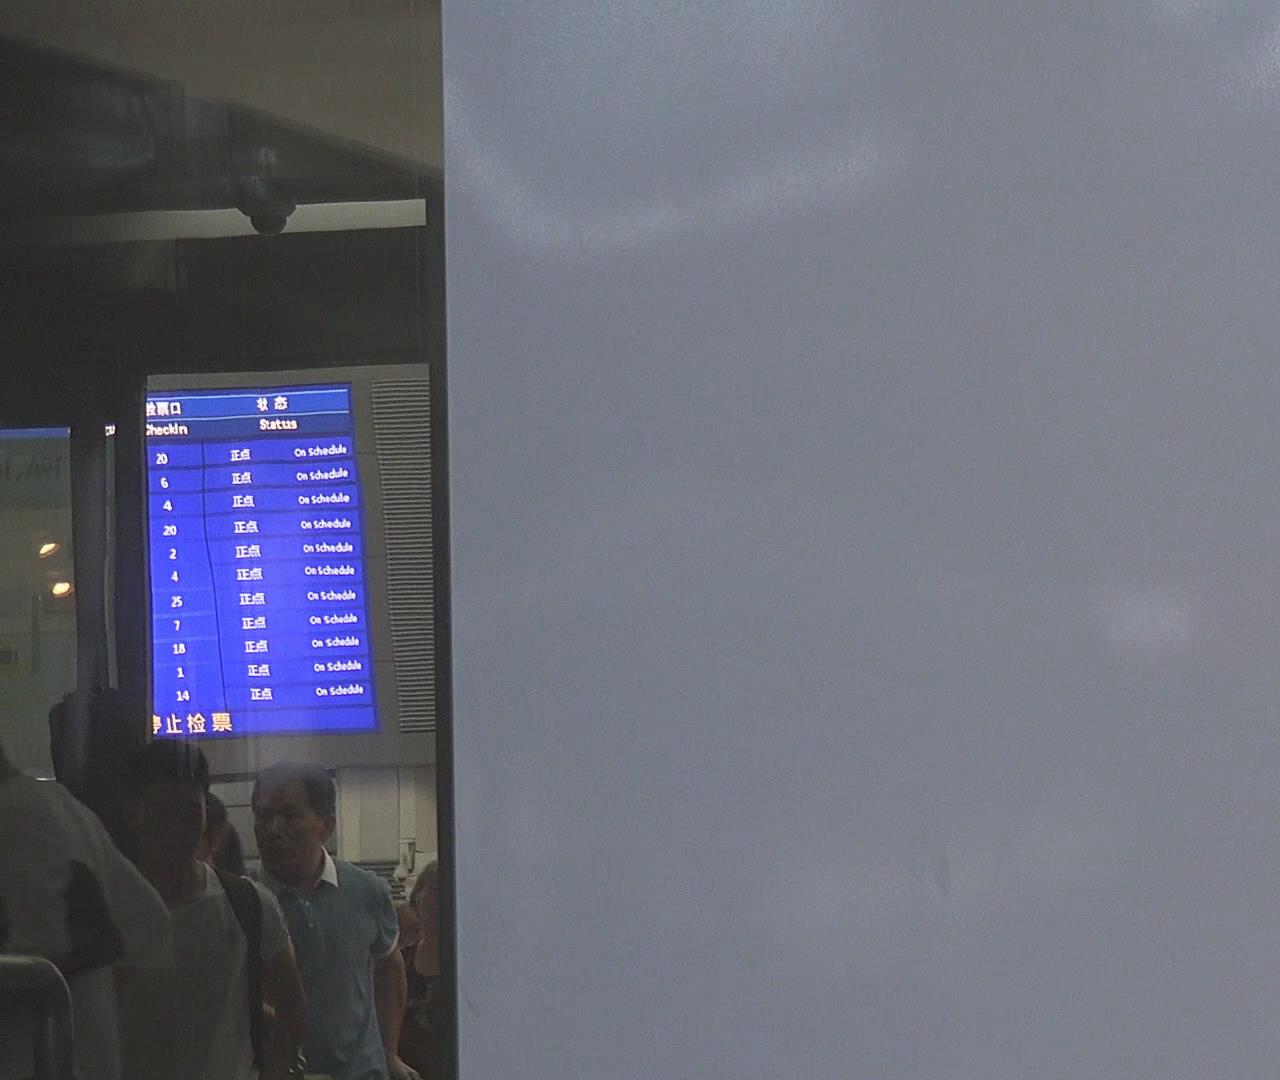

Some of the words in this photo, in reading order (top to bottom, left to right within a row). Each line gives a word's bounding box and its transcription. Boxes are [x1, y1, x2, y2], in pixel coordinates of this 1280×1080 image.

[256, 396, 288, 411] 状态
[260, 419, 298, 430] Status
[230, 449, 251, 461] 正点
[294, 448, 307, 458] On
[308, 444, 347, 457] Schedule
[156, 453, 168, 464] 20
[232, 472, 252, 484] 正点
[296, 472, 308, 481] On
[309, 468, 349, 480] Schedule
[160, 477, 169, 488] 6
[233, 495, 255, 507] 正点
[298, 495, 310, 504] On
[311, 493, 350, 504] Schedule
[163, 500, 173, 511] 4
[234, 521, 259, 533] 正点
[301, 520, 312, 529] On
[313, 518, 351, 529] Schedule
[163, 525, 177, 536] 20
[169, 548, 177, 559] 2
[236, 545, 261, 558] 正点
[303, 544, 314, 553] On
[315, 542, 353, 553] Schedule
[171, 570, 179, 582] 4
[237, 568, 263, 580] 正点
[304, 566, 317, 575] On
[317, 565, 355, 576] Schedule
[171, 596, 183, 607] 25
[240, 593, 265, 605] 正点
[307, 592, 319, 601] On
[320, 590, 356, 601] Schedule
[242, 617, 267, 629] 正点
[309, 616, 321, 625] On
[323, 613, 358, 624] Schedule
[173, 620, 181, 631] 7
[245, 640, 268, 652] 正点
[311, 640, 323, 648] On
[325, 636, 360, 647] Schedule
[173, 643, 186, 654] 18
[248, 664, 270, 676] 正点
[313, 663, 325, 672] On
[327, 660, 362, 672] Schedule
[177, 667, 185, 678] 1
[176, 690, 190, 701] 14
[251, 688, 273, 700] 正点
[315, 687, 328, 697] On
[330, 684, 364, 696] Schedule
